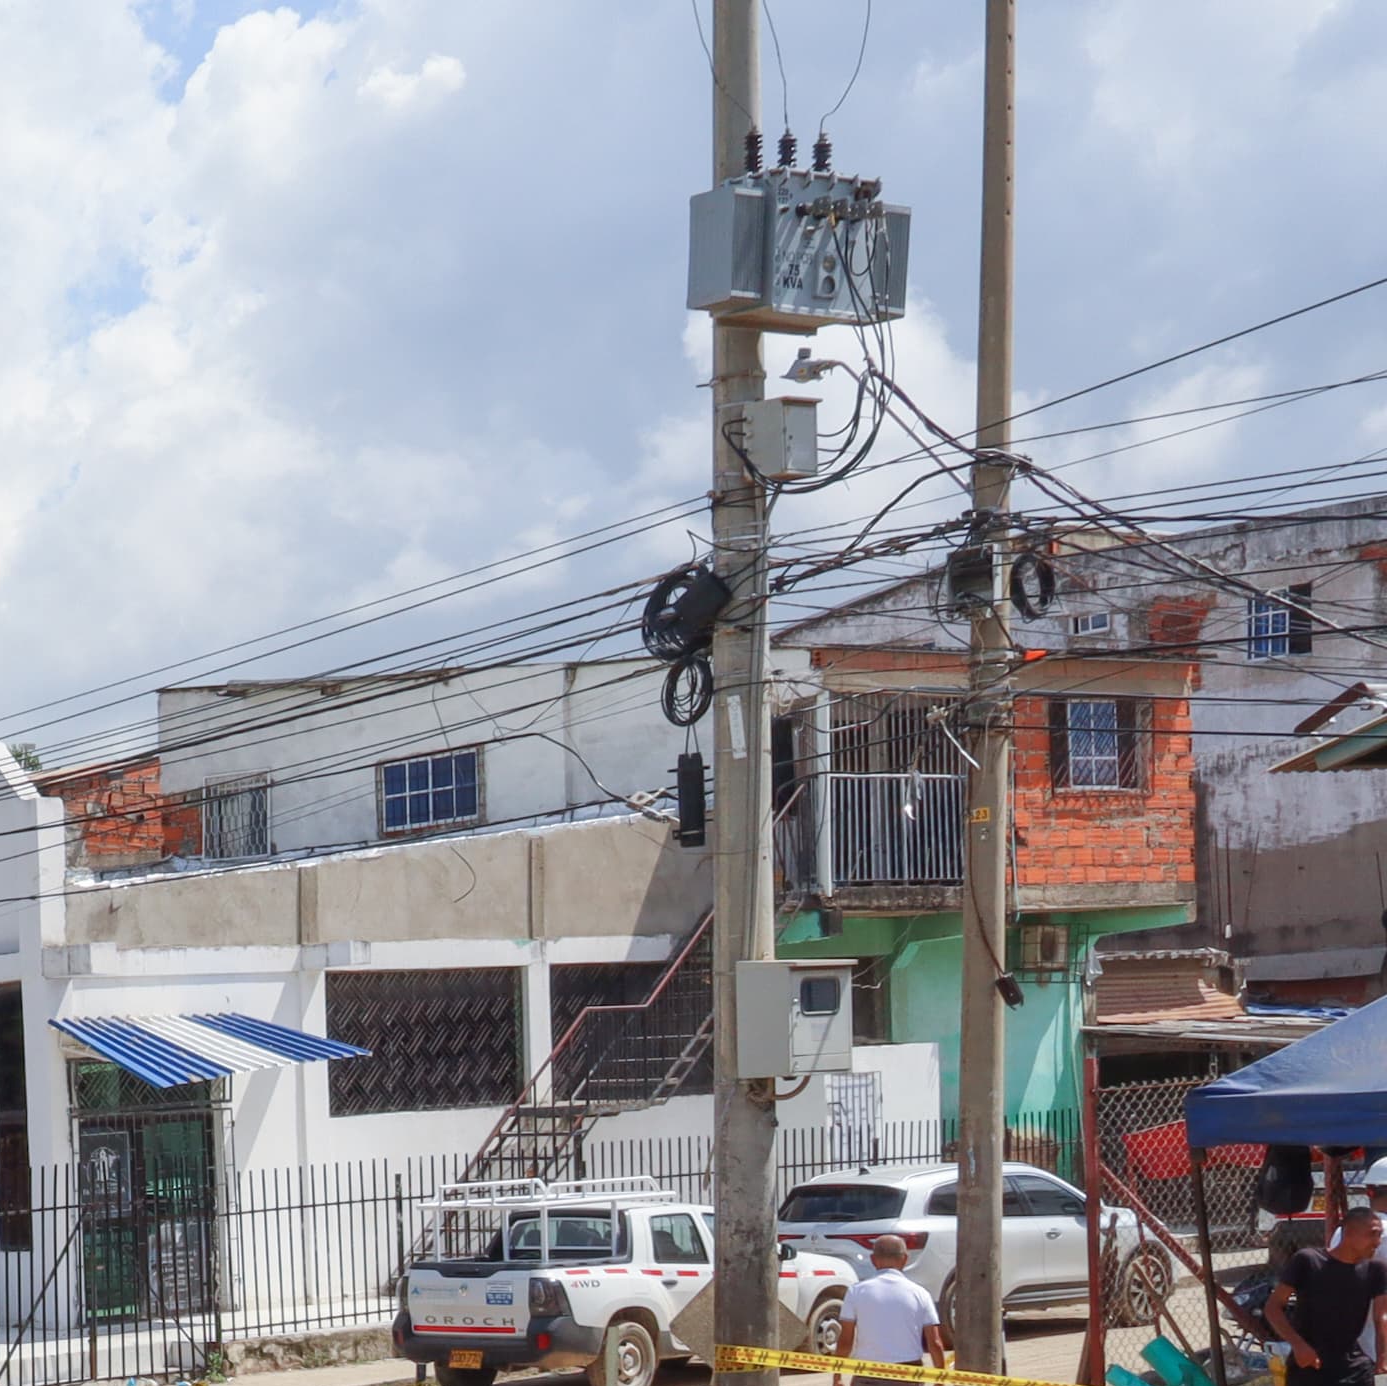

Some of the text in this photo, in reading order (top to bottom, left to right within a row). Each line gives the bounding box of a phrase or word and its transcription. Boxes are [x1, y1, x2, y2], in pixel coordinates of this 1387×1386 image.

[788, 263, 800, 276] 75
[783, 277, 803, 289] KVA
[570, 1279, 601, 1288] 4WD
[424, 1315, 515, 1326] OROCH
